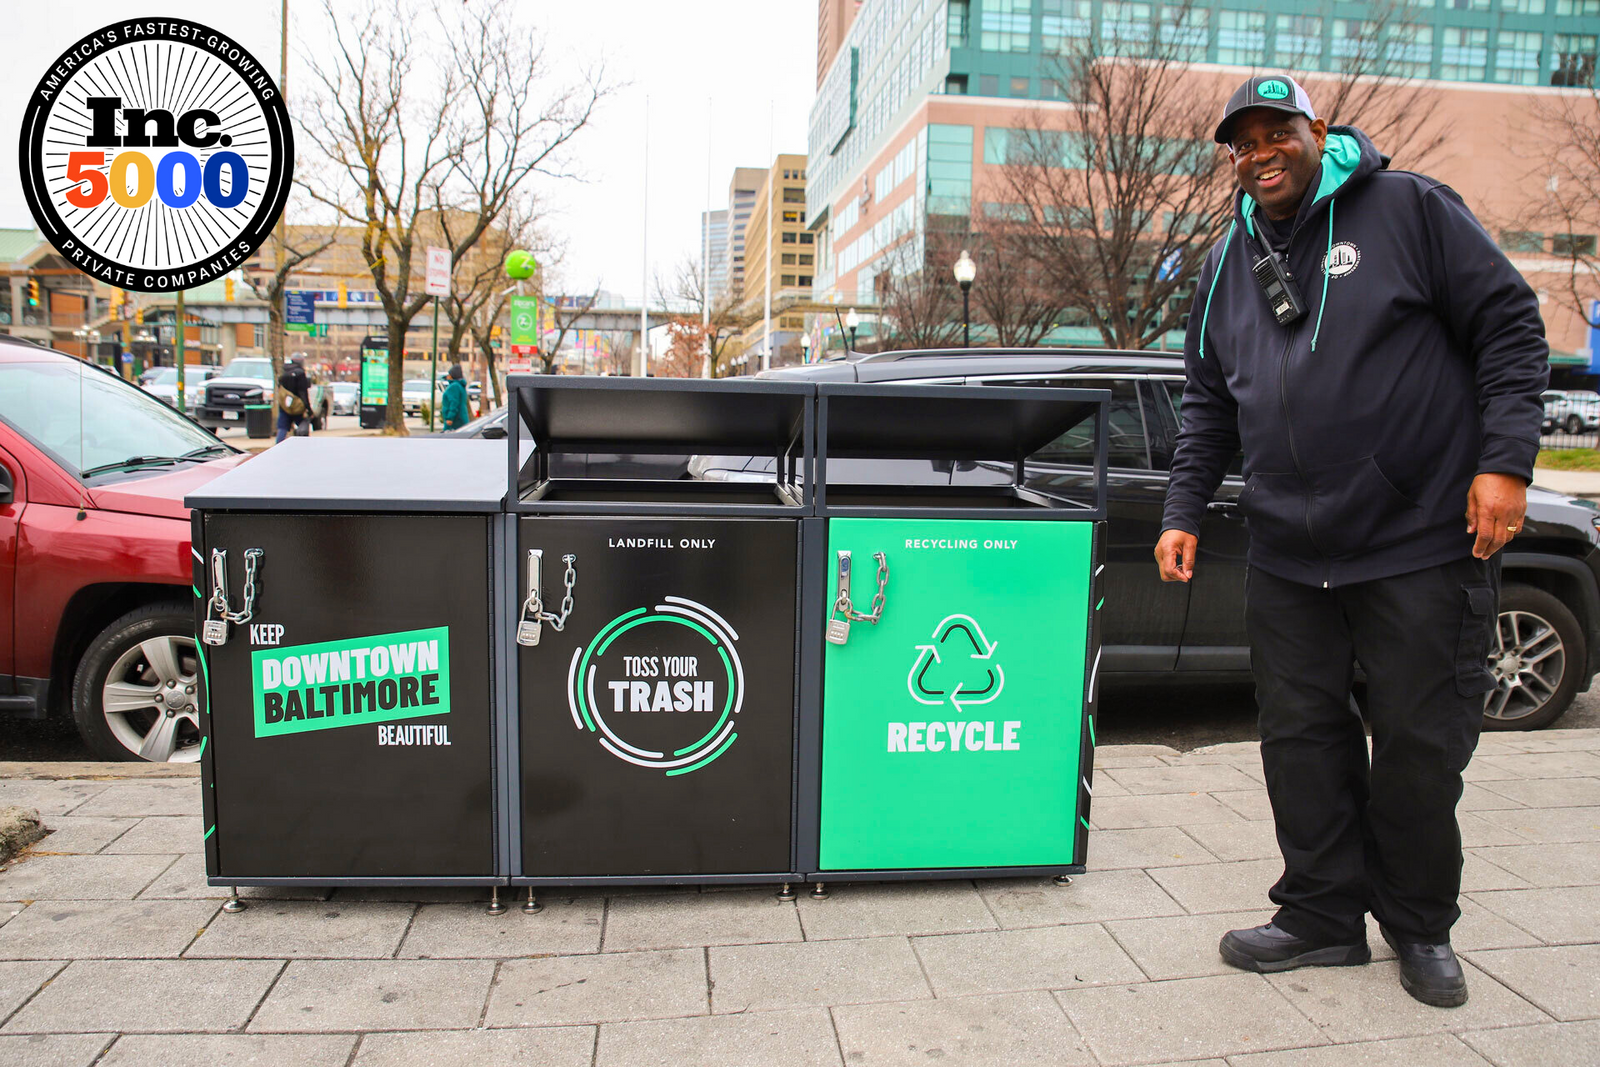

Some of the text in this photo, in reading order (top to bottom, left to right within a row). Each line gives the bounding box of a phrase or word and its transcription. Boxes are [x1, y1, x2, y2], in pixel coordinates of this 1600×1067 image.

[608, 538, 716, 549] LANDFILL ONLY
[905, 539, 1018, 549] RECYCLING ONLY
[249, 623, 285, 645] KEEP
[261, 639, 439, 690] DOWNTOWN
[623, 656, 698, 677] TOSS YOUR
[264, 673, 440, 724] BALTIMORE
[608, 681, 714, 712] TRASH
[377, 725, 452, 746] BEAUTIFUL
[887, 720, 1021, 752] RECYCLE
